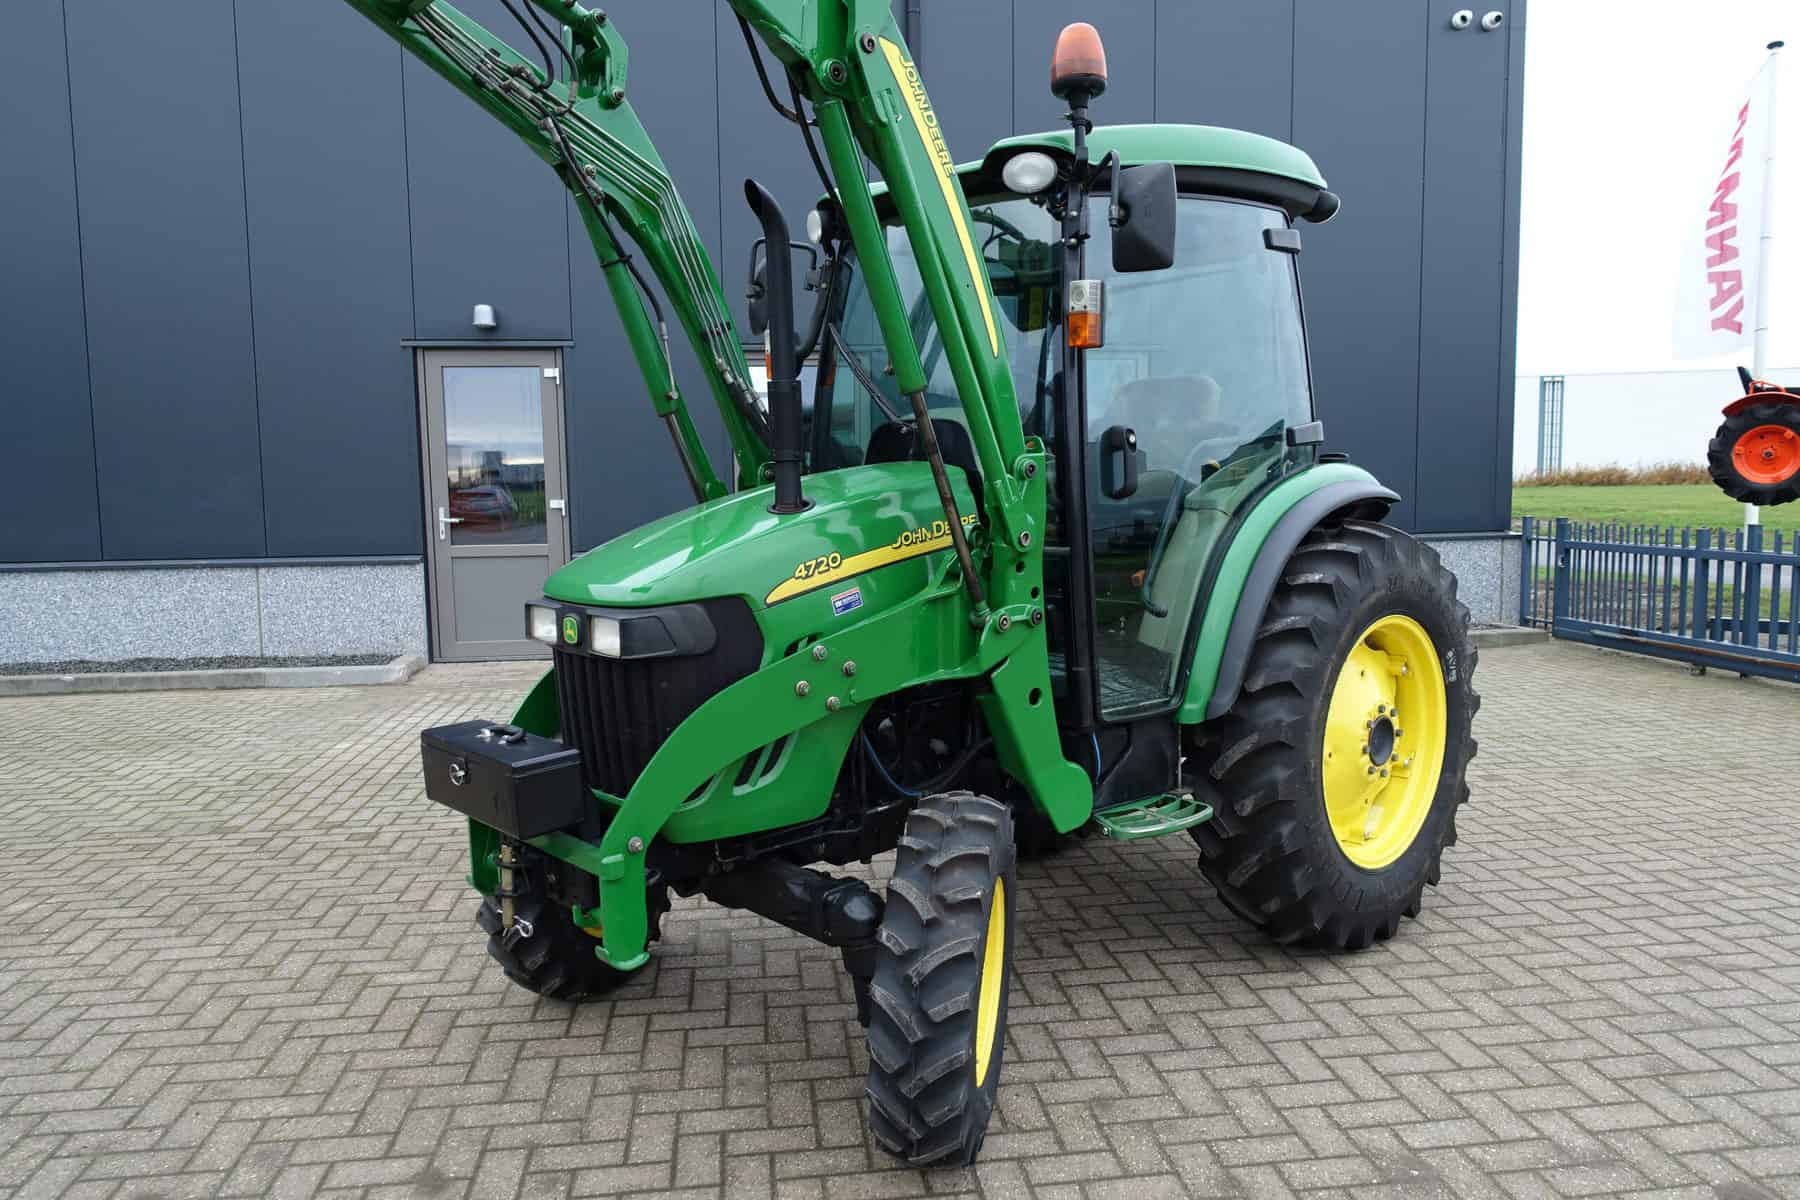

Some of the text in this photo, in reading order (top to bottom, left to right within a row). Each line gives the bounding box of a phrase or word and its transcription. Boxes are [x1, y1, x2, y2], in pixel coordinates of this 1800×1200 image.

[899, 56, 956, 177] JOHN DEERE
[891, 527, 931, 550] JOHN
[794, 552, 841, 579] 4720
